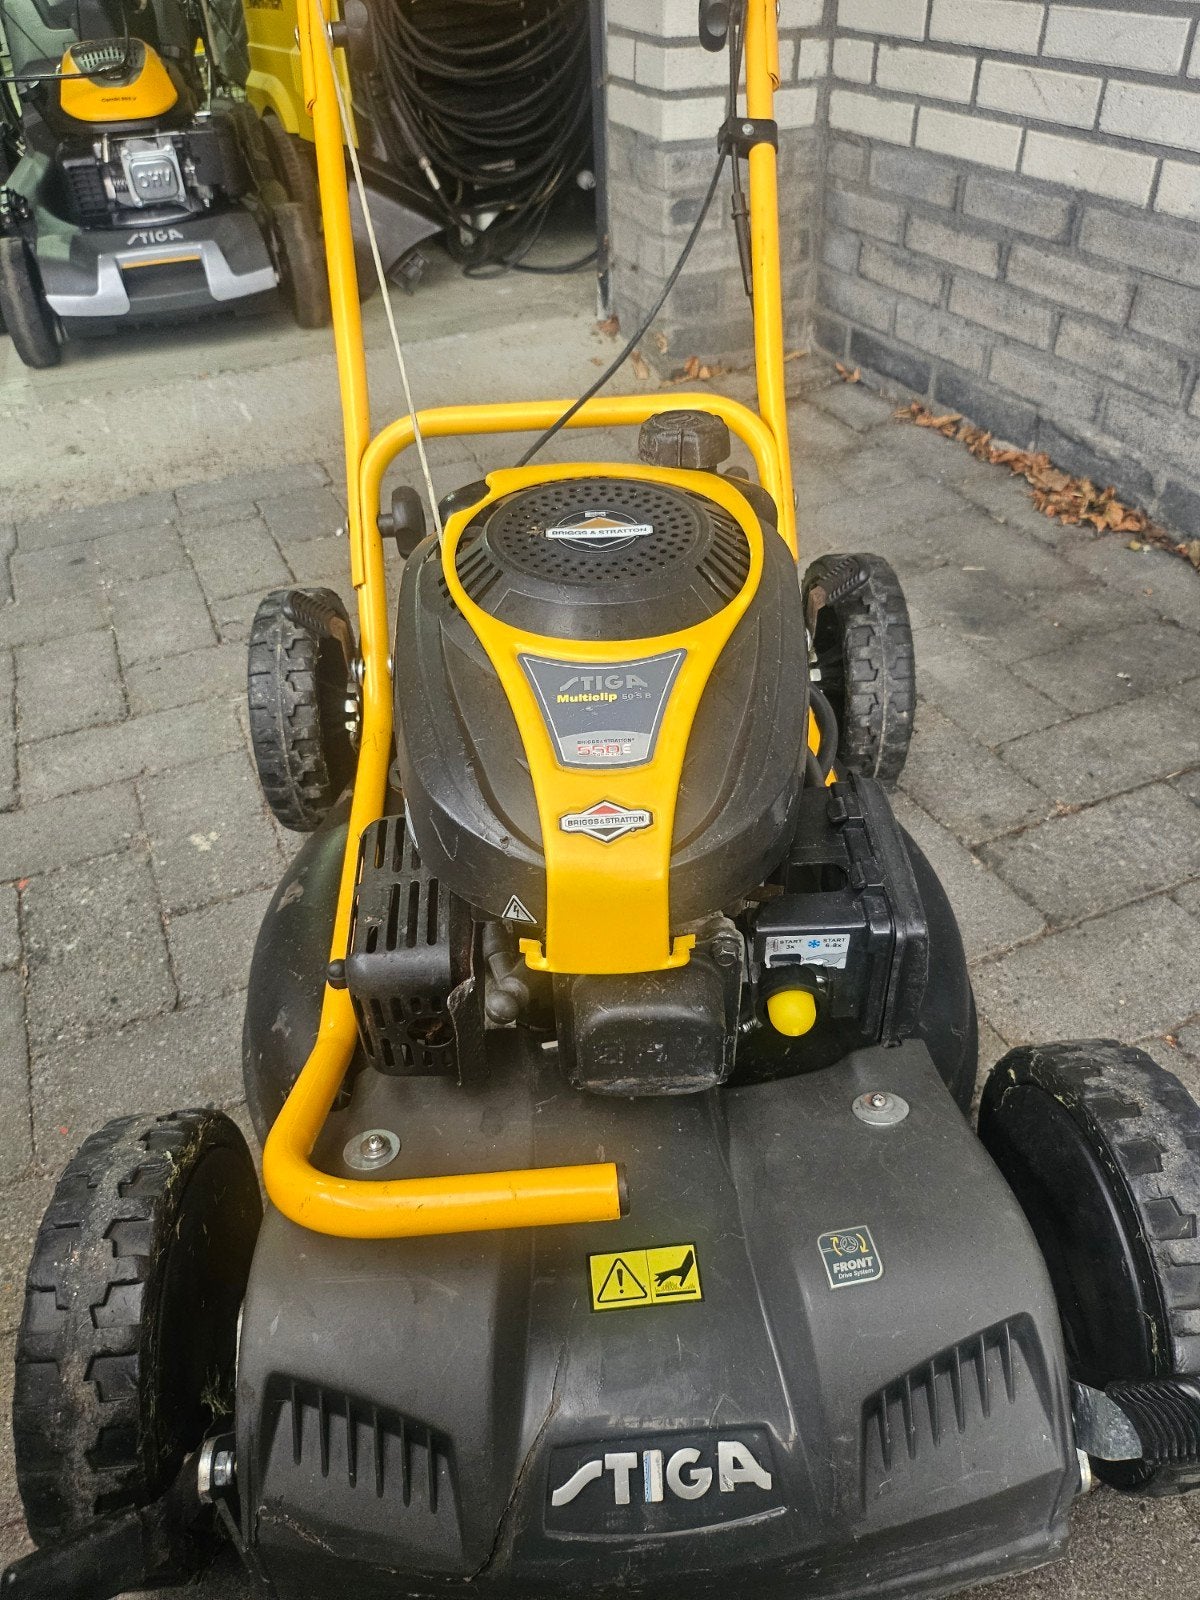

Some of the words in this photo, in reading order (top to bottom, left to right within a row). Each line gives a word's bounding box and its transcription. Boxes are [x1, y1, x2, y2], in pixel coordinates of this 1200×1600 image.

[126, 229, 184, 246] STIGA
[598, 527, 647, 535] STRATTON
[559, 674, 648, 692] STIGA
[556, 692, 618, 703] Multiclip
[832, 1256, 874, 1273] FRONT
[854, 1268, 874, 1277] System
[551, 1440, 772, 1507] STIGA
